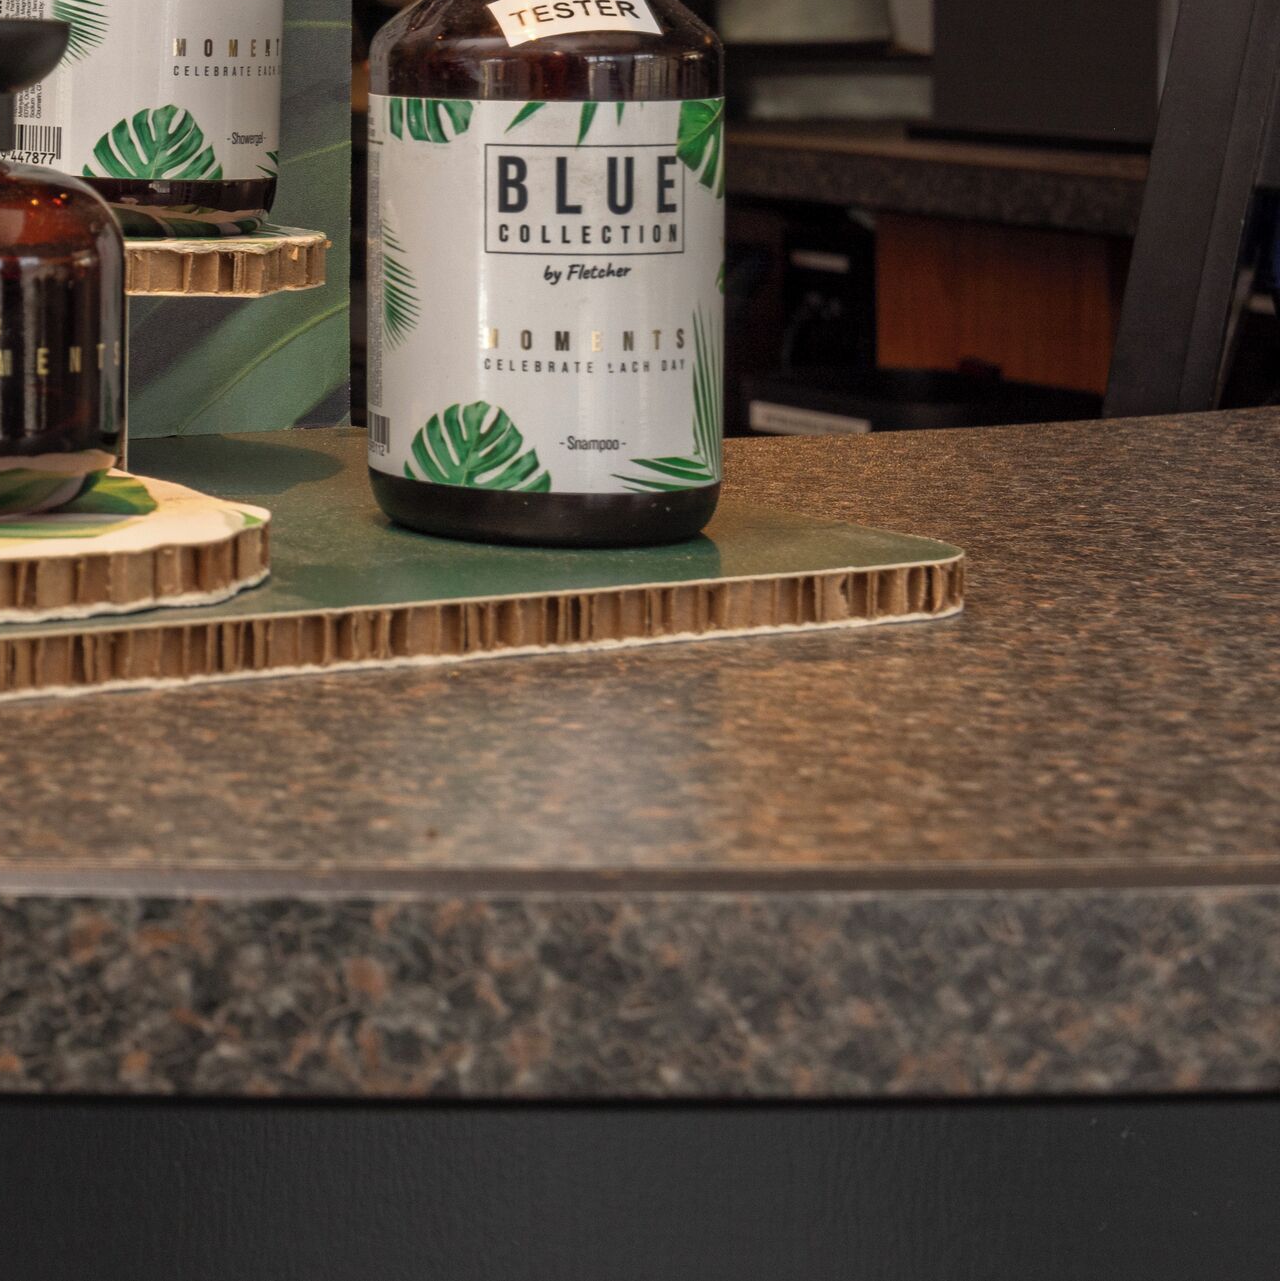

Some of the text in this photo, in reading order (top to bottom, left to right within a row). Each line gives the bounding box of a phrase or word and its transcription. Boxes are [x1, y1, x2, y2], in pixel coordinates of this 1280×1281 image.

[508, 0, 641, 27] TESTER
[173, 65, 251, 77] CELEBRATE
[497, 155, 678, 215] BLUE
[498, 223, 678, 245] COLLECTION
[543, 262, 632, 283] by Fletcher
[484, 358, 594, 373] CELEBRATE
[661, 358, 686, 372] DAY
